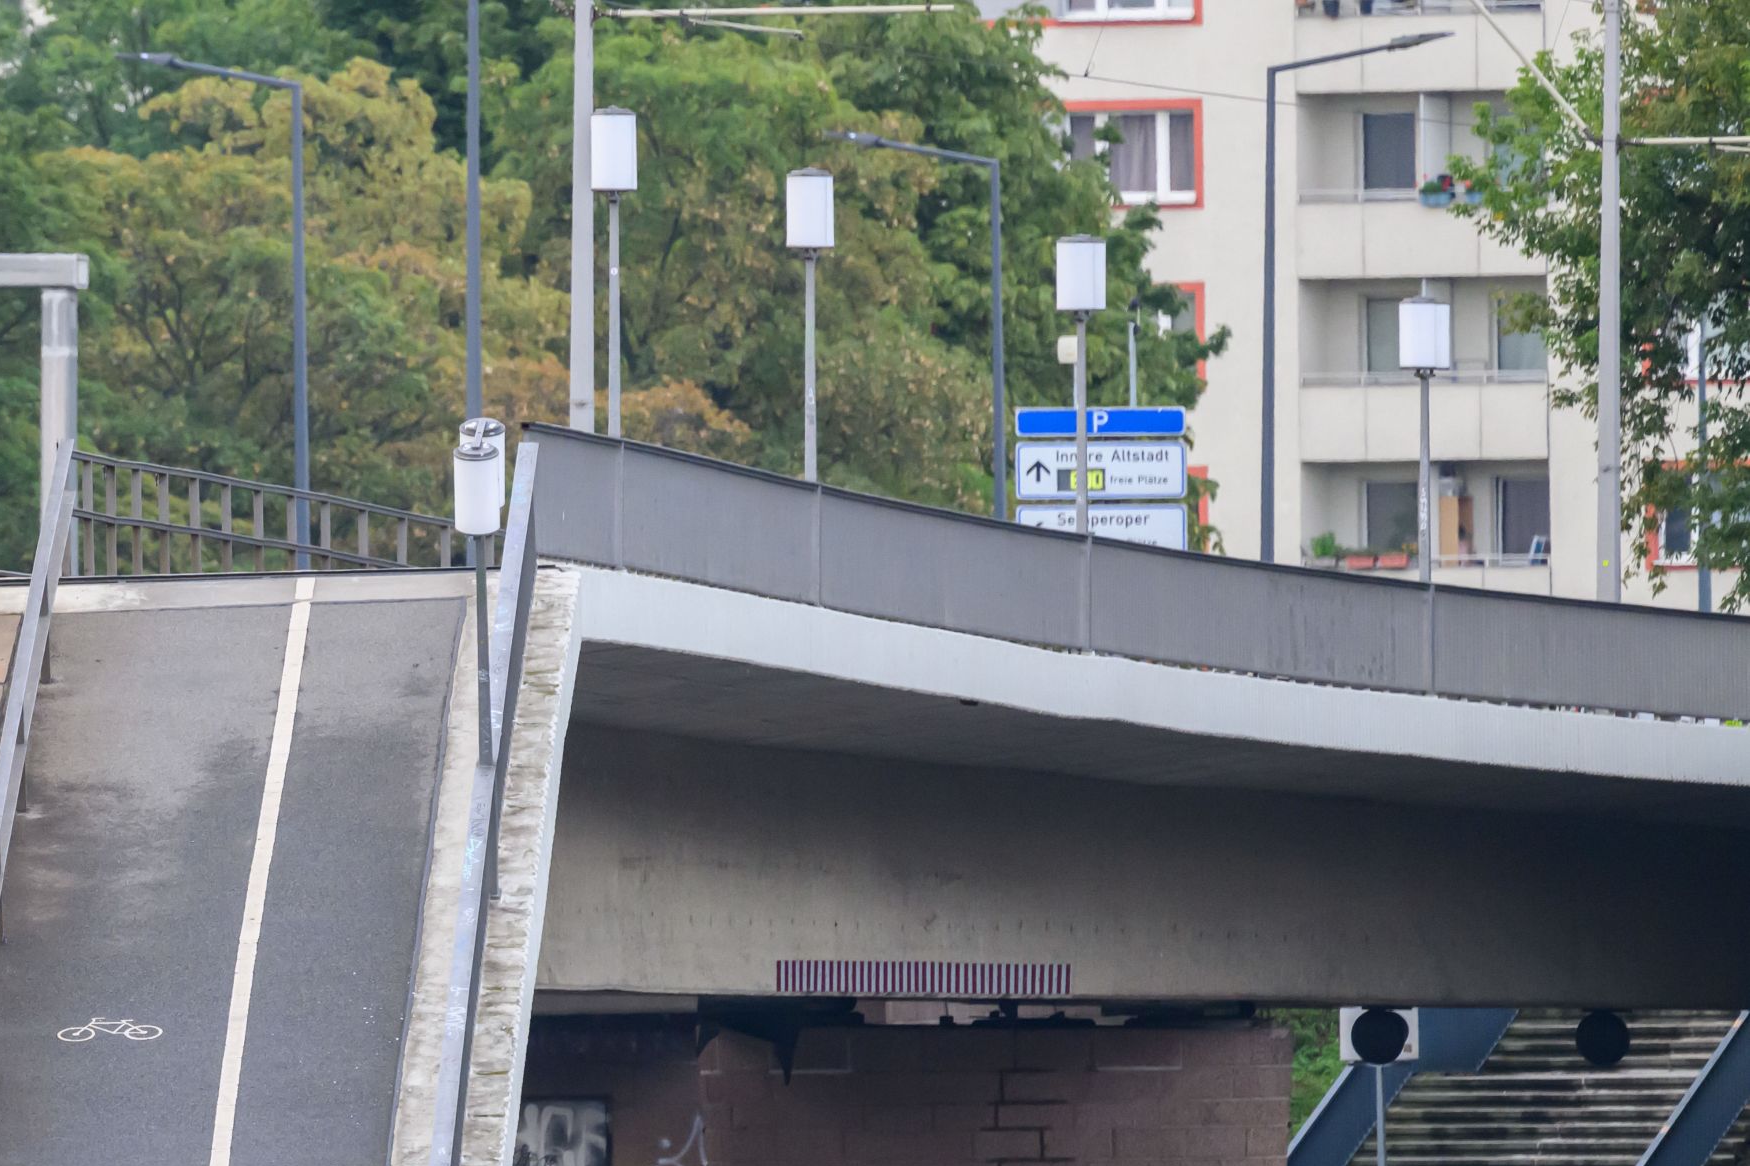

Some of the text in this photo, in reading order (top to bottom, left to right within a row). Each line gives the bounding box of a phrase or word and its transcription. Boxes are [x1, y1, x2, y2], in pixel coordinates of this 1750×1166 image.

[1092, 411, 1109, 433] P
[1056, 449, 1169, 462] Innre Altstadt
[1110, 475, 1133, 485] freie
[1057, 512, 1150, 528] Seperoper
